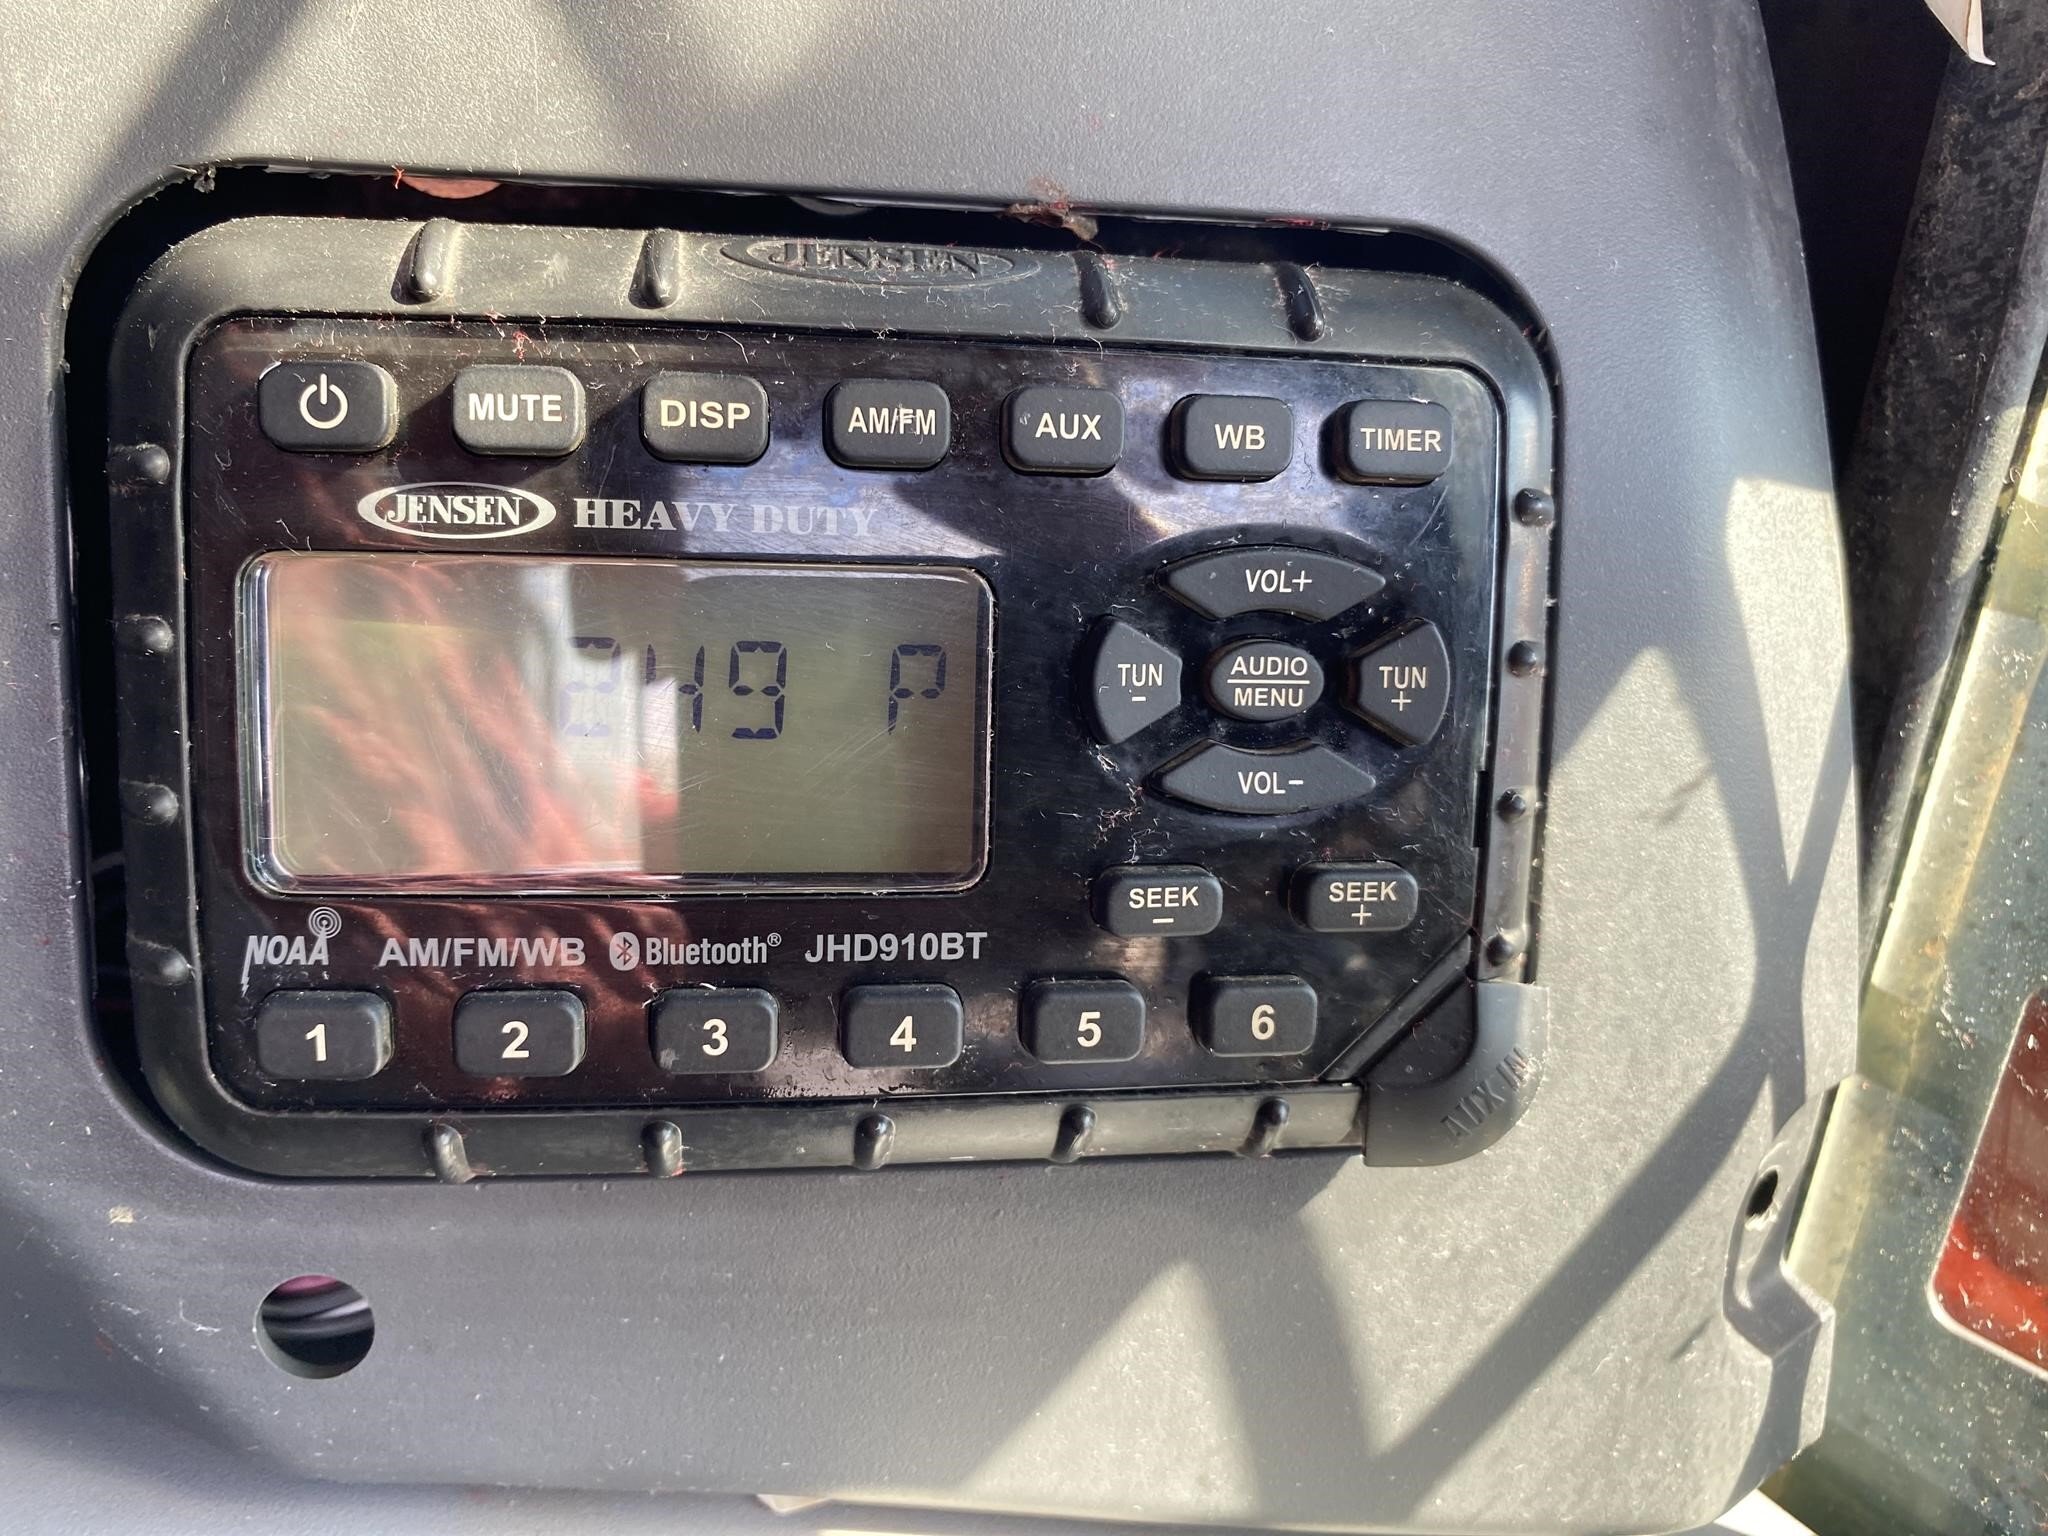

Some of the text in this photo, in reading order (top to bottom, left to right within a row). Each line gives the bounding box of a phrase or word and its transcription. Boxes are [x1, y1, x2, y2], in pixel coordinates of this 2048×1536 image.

[767, 240, 990, 279] JENSEN
[467, 393, 563, 423] MUTE
[658, 399, 751, 430] DISP
[847, 406, 937, 436] AM/FM
[1034, 413, 1101, 441] AUX
[1214, 424, 1267, 451] WB
[1360, 427, 1442, 453] TIMER
[384, 494, 523, 526] JENSEN
[573, 498, 878, 538] HEAVY DUTY
[1245, 569, 1313, 594] VOL+
[1117, 663, 1163, 687] TUN
[1230, 655, 1308, 677] AUDIO
[1378, 665, 1427, 689] TUN
[1233, 687, 1304, 708] MENU
[1128, 886, 1200, 909] SEEK
[1328, 880, 1398, 903] SEEK
[378, 936, 587, 968] AM/FM/WB
[804, 931, 988, 964] JHD910BT
[702, 1018, 730, 1057] 3
[889, 1016, 917, 1053] 4
[1076, 1011, 1102, 1048] 5
[1251, 1004, 1275, 1041] 6
[304, 1023, 328, 1062] 1
[501, 1021, 530, 1060] 2
[1440, 1079, 1505, 1138] AUX
